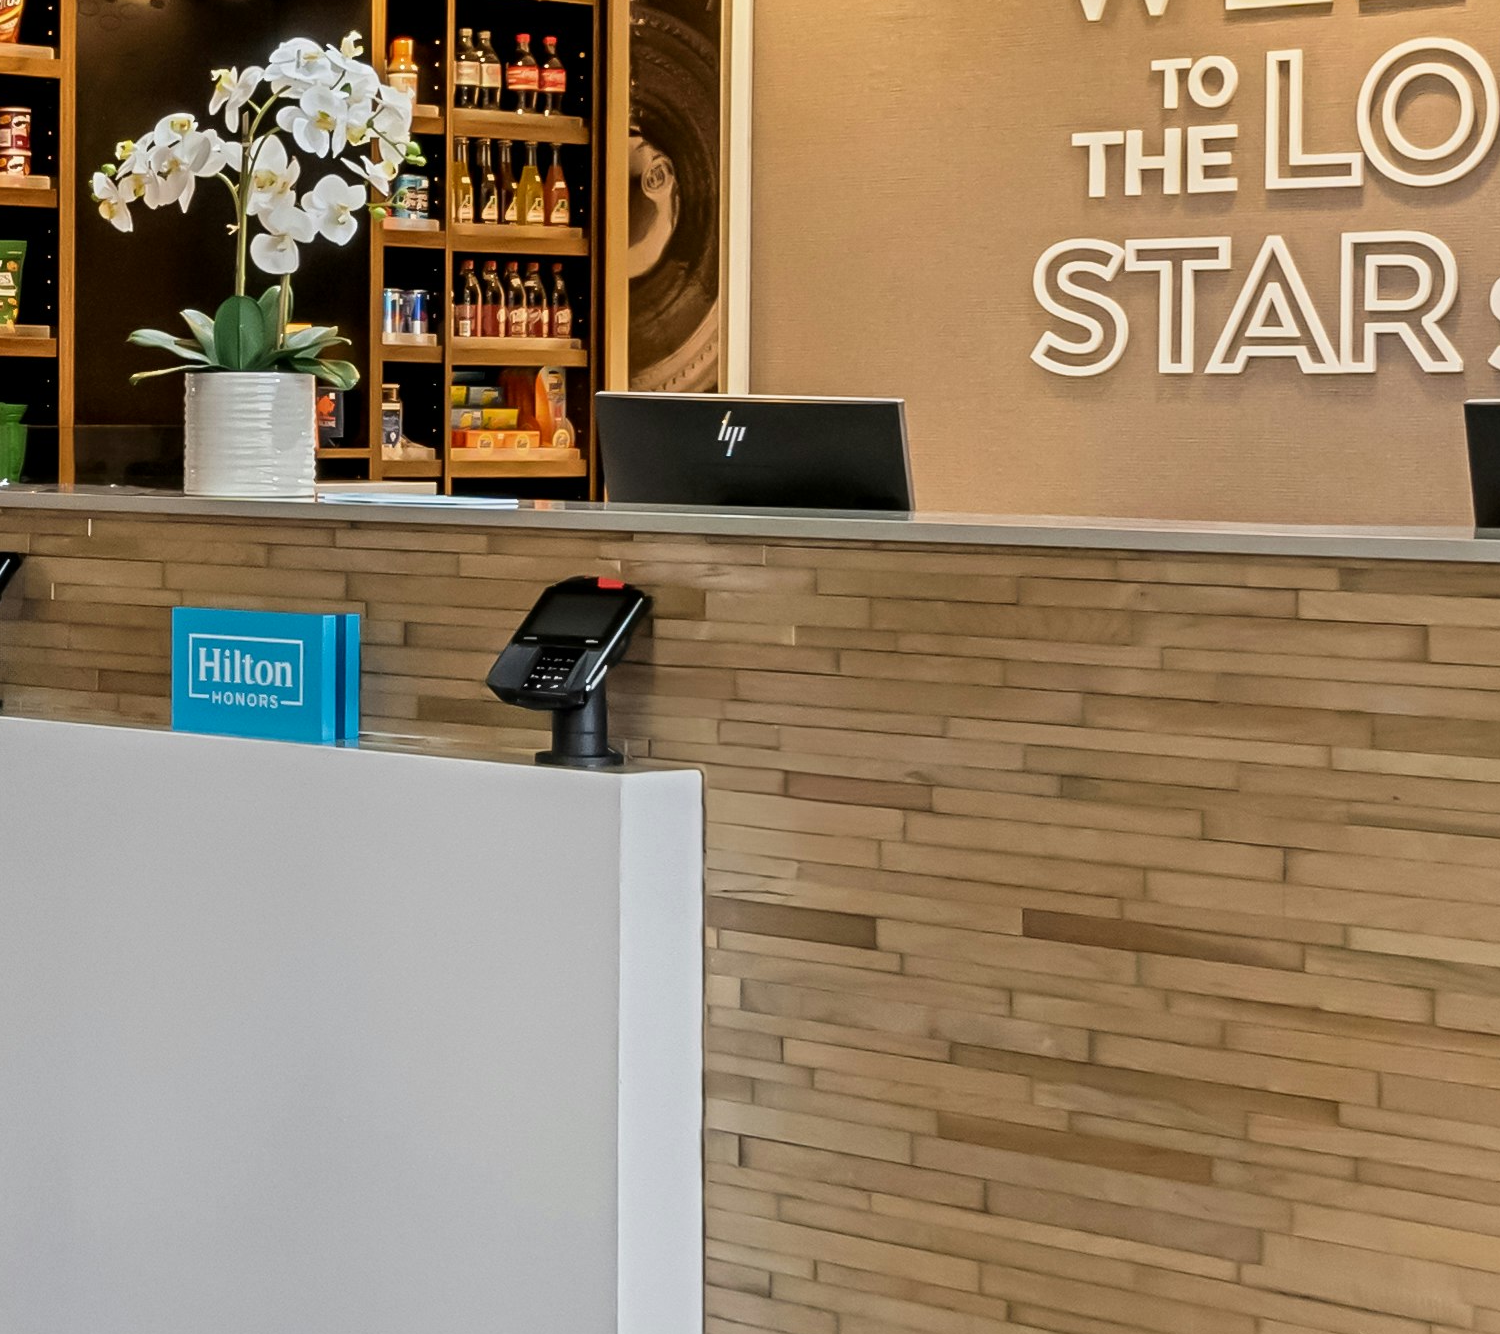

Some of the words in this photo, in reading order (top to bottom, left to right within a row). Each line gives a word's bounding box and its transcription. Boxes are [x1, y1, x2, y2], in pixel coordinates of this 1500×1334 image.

[1150, 54, 1239, 110] TO
[1071, 123, 1240, 201] THE
[1030, 229, 1465, 376] STAR
[718, 410, 747, 456] hp
[199, 647, 293, 688] Hilton
[211, 691, 279, 709] HONORS
